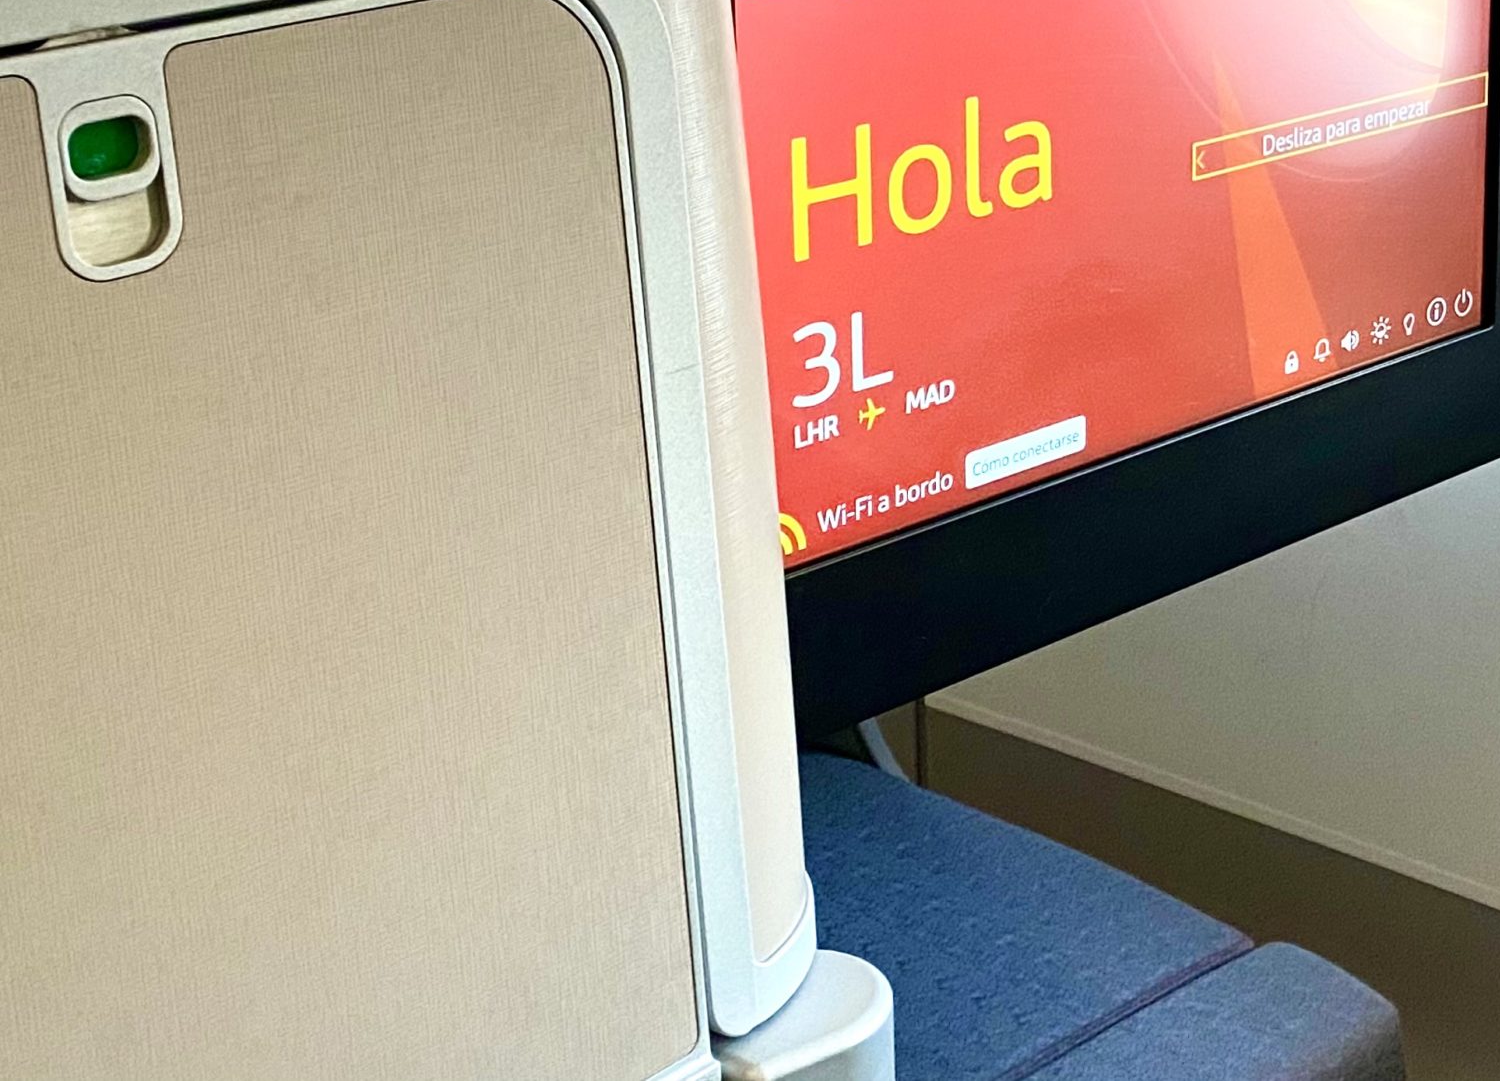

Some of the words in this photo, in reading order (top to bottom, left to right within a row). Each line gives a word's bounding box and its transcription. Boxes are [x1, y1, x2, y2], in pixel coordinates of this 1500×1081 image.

[1262, 125, 1322, 156] Desliza
[1326, 117, 1360, 147] para
[1364, 99, 1431, 129] empezar
[791, 96, 1053, 262] Hola
[792, 311, 894, 408] 3L
[794, 415, 840, 449] LHR
[905, 379, 955, 414] MAD
[1013, 431, 1079, 463] conectarse
[817, 495, 873, 532] Wi-Fi
[878, 495, 890, 512] a
[895, 470, 954, 507] bordo
